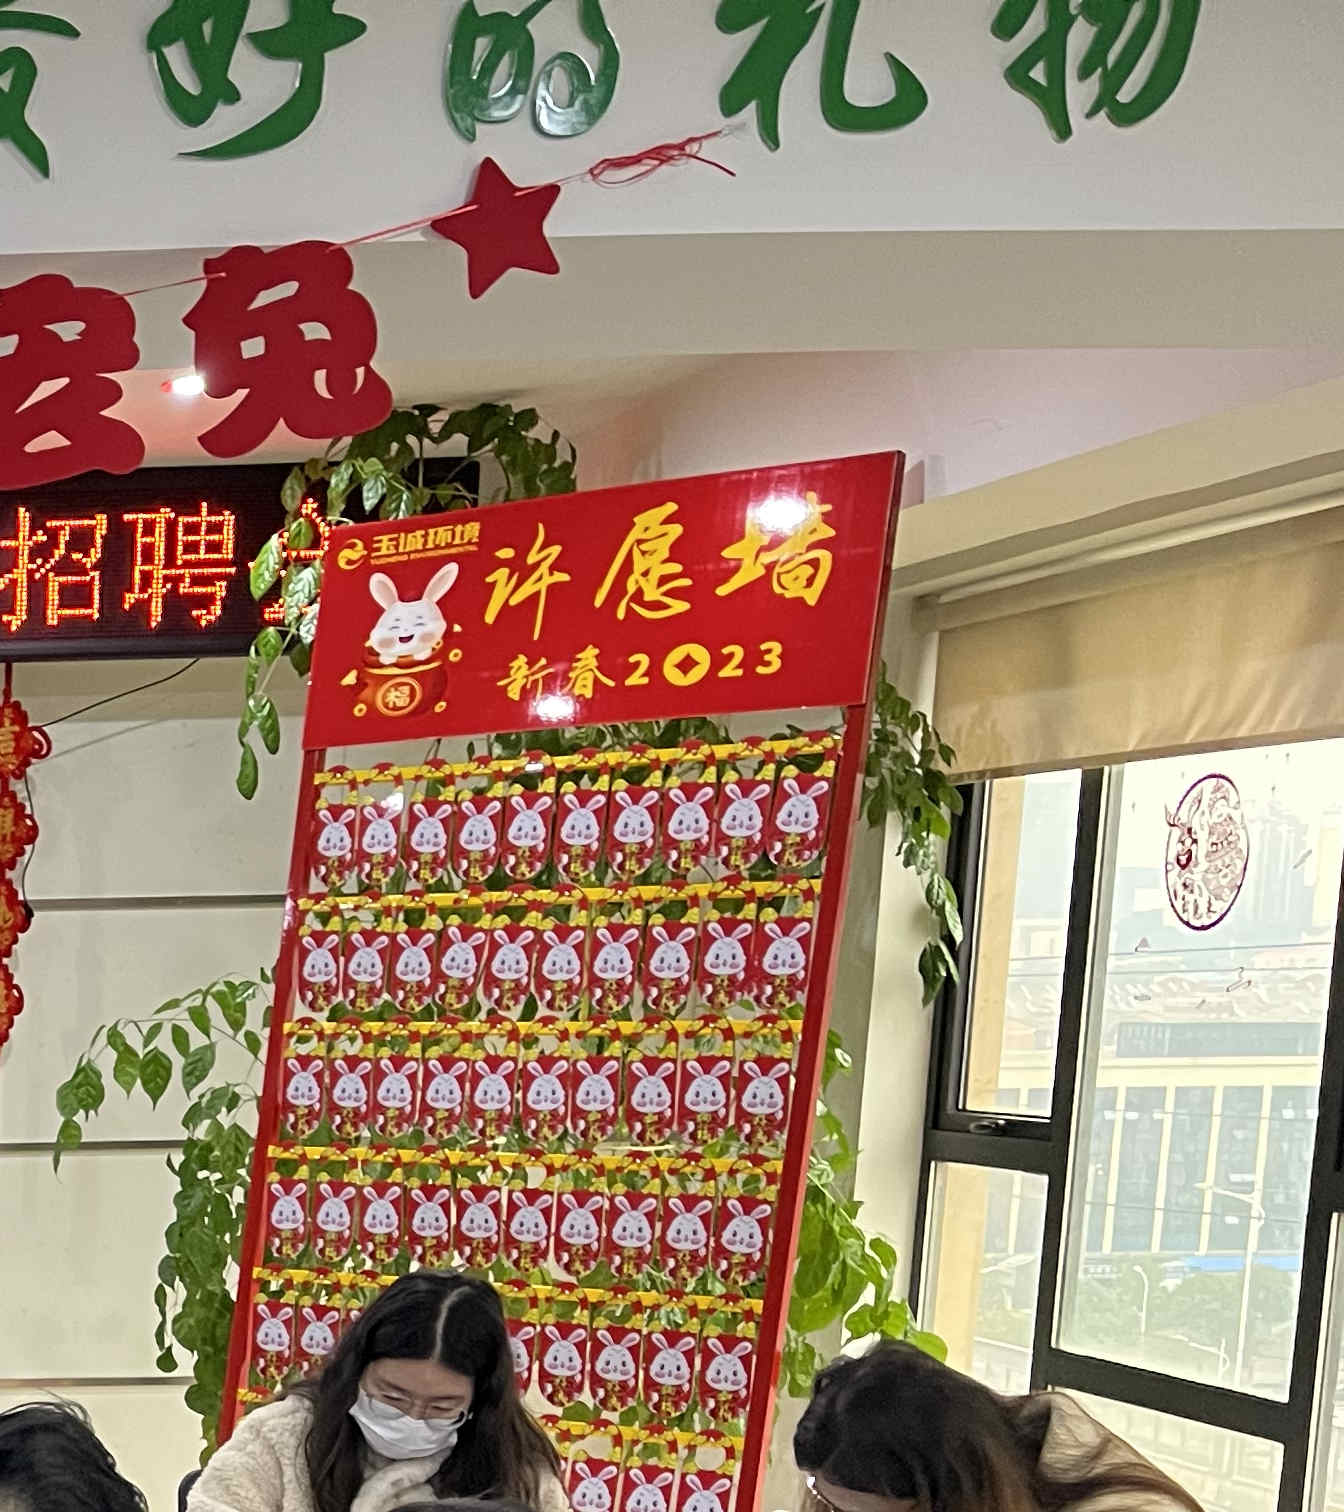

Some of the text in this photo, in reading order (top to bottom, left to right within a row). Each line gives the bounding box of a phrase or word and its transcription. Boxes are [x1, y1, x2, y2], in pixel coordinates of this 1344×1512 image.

[370, 522, 481, 557] 玉诚环境
[482, 490, 839, 641] 许愿墙
